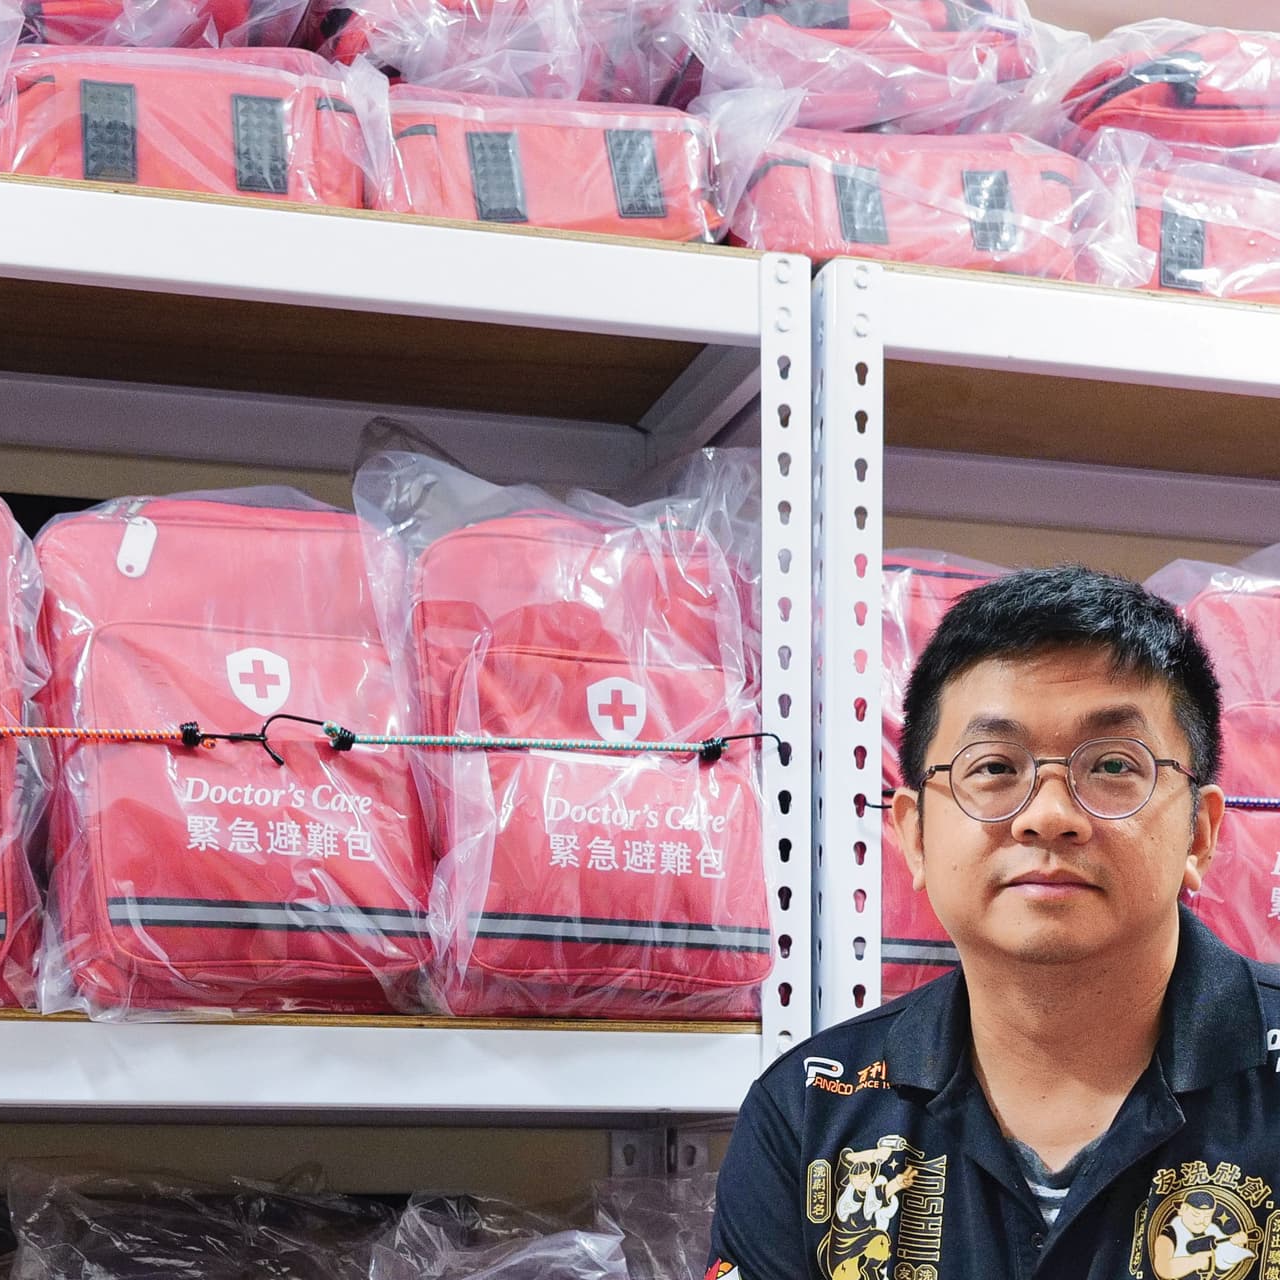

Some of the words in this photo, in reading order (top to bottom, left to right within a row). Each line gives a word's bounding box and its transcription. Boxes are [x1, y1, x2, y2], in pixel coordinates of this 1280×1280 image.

[185, 777, 308, 810] Doctor's
[311, 786, 373, 814] Care
[548, 797, 658, 829] Doctor's
[185, 815, 375, 861] 緊急避難包
[548, 834, 726, 878] 緊急避難包
